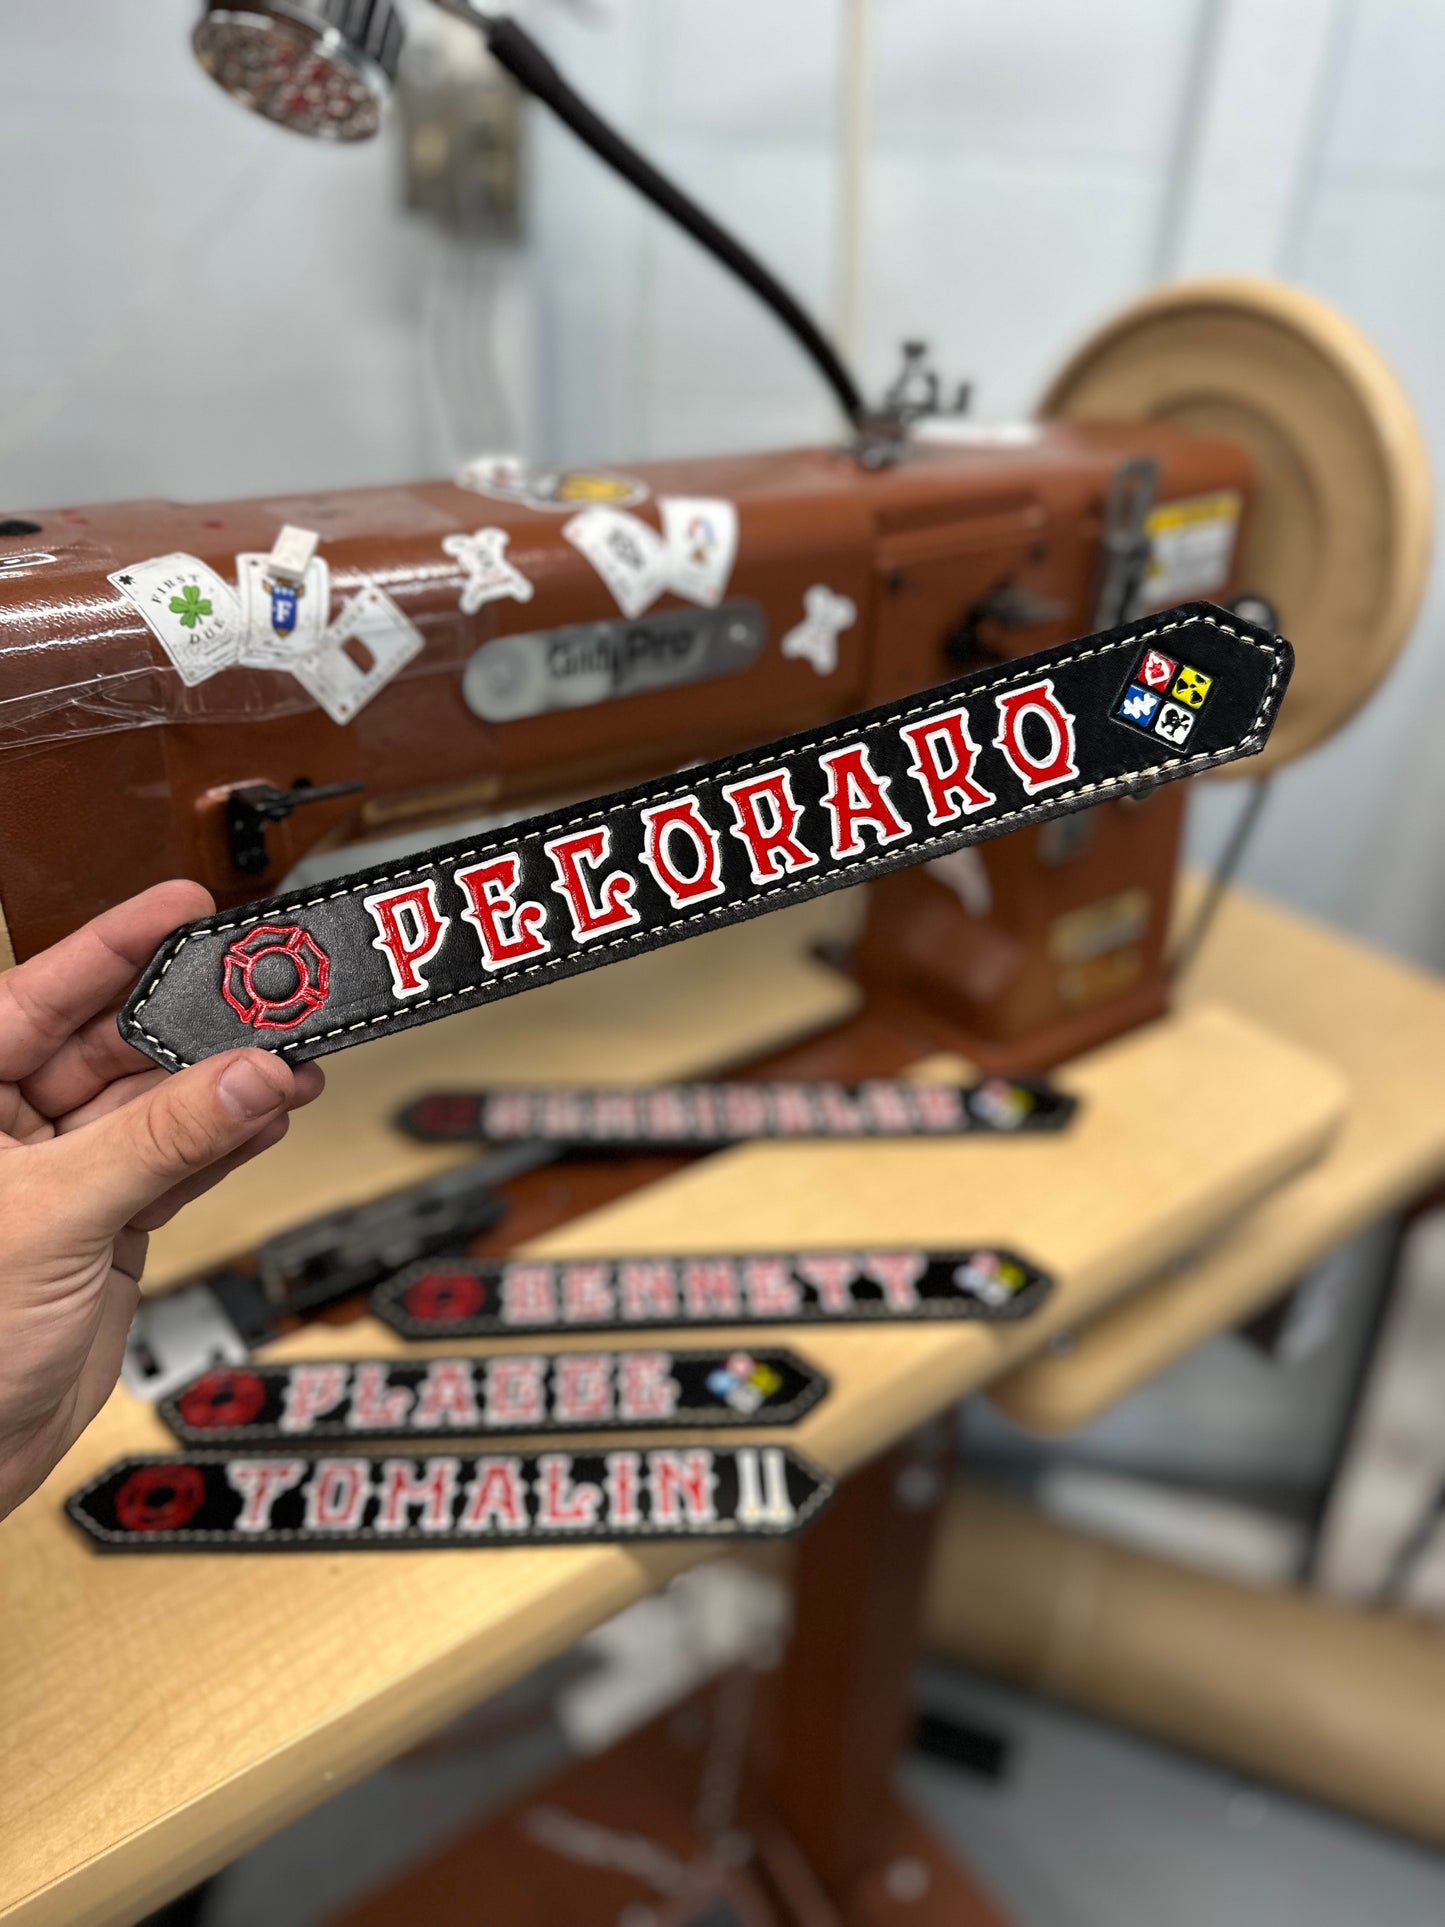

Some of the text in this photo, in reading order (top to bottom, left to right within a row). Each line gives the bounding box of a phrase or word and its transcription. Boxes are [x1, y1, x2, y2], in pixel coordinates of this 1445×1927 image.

[151, 573, 200, 604] FIRST
[275, 599, 294, 623] F
[189, 618, 225, 645] DUE
[365, 679, 1080, 998] PECORARO
[227, 1448, 720, 1532] TOMALIN
